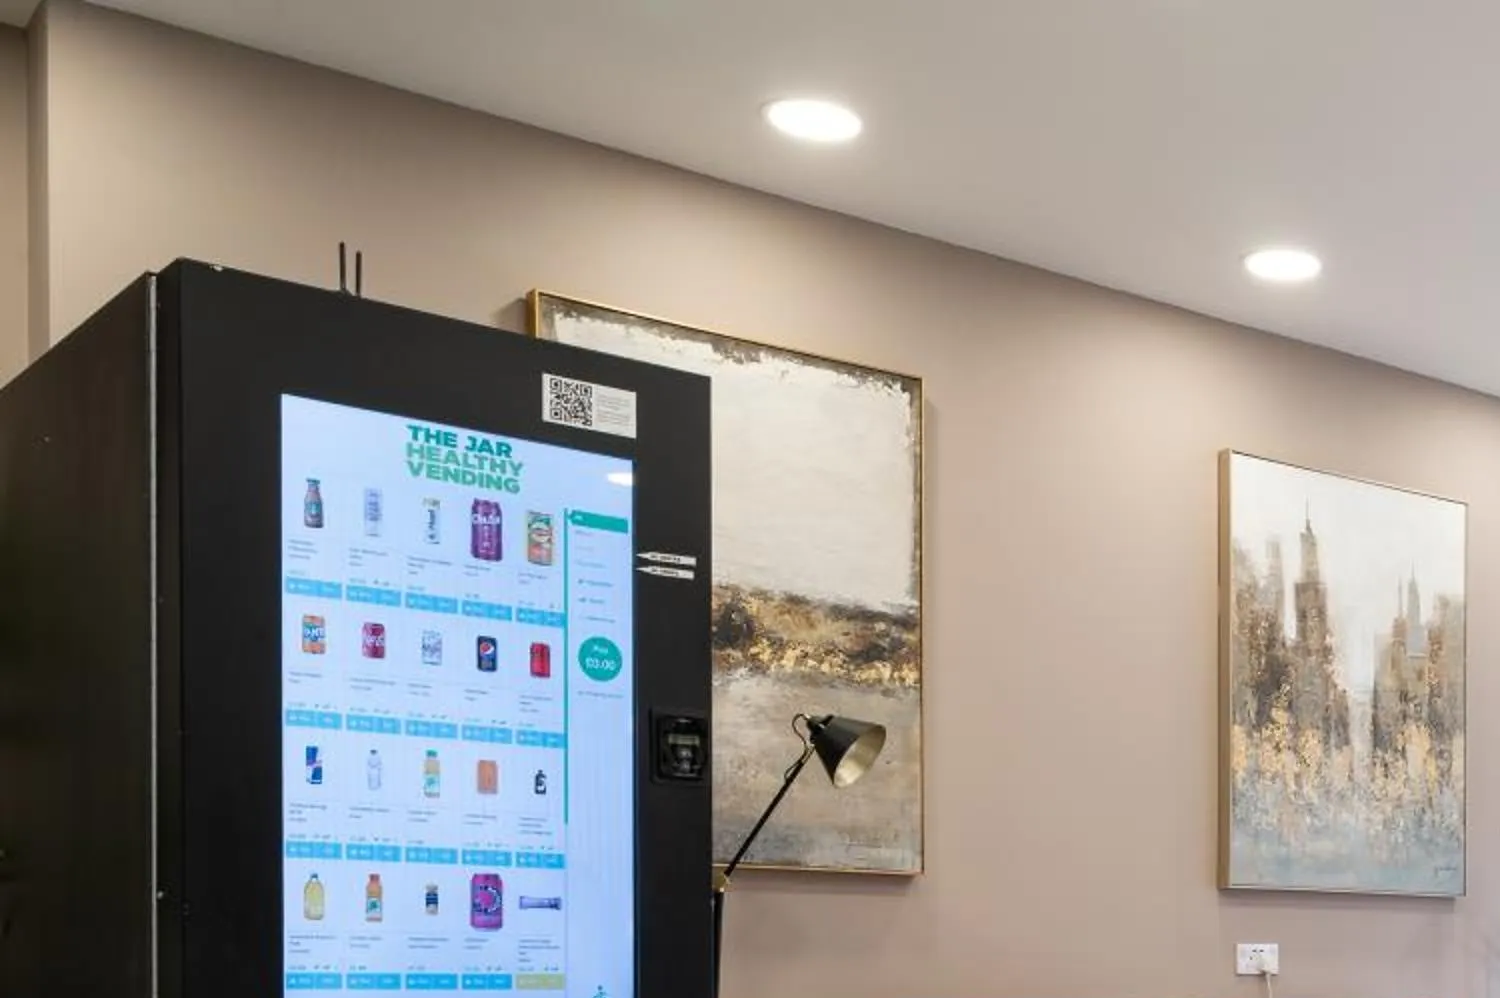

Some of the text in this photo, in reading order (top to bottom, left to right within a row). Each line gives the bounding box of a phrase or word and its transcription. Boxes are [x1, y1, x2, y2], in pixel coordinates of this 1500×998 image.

[406, 424, 513, 458] THE JAR
[406, 441, 523, 476] HEALTHY
[406, 459, 521, 494] VENDING
